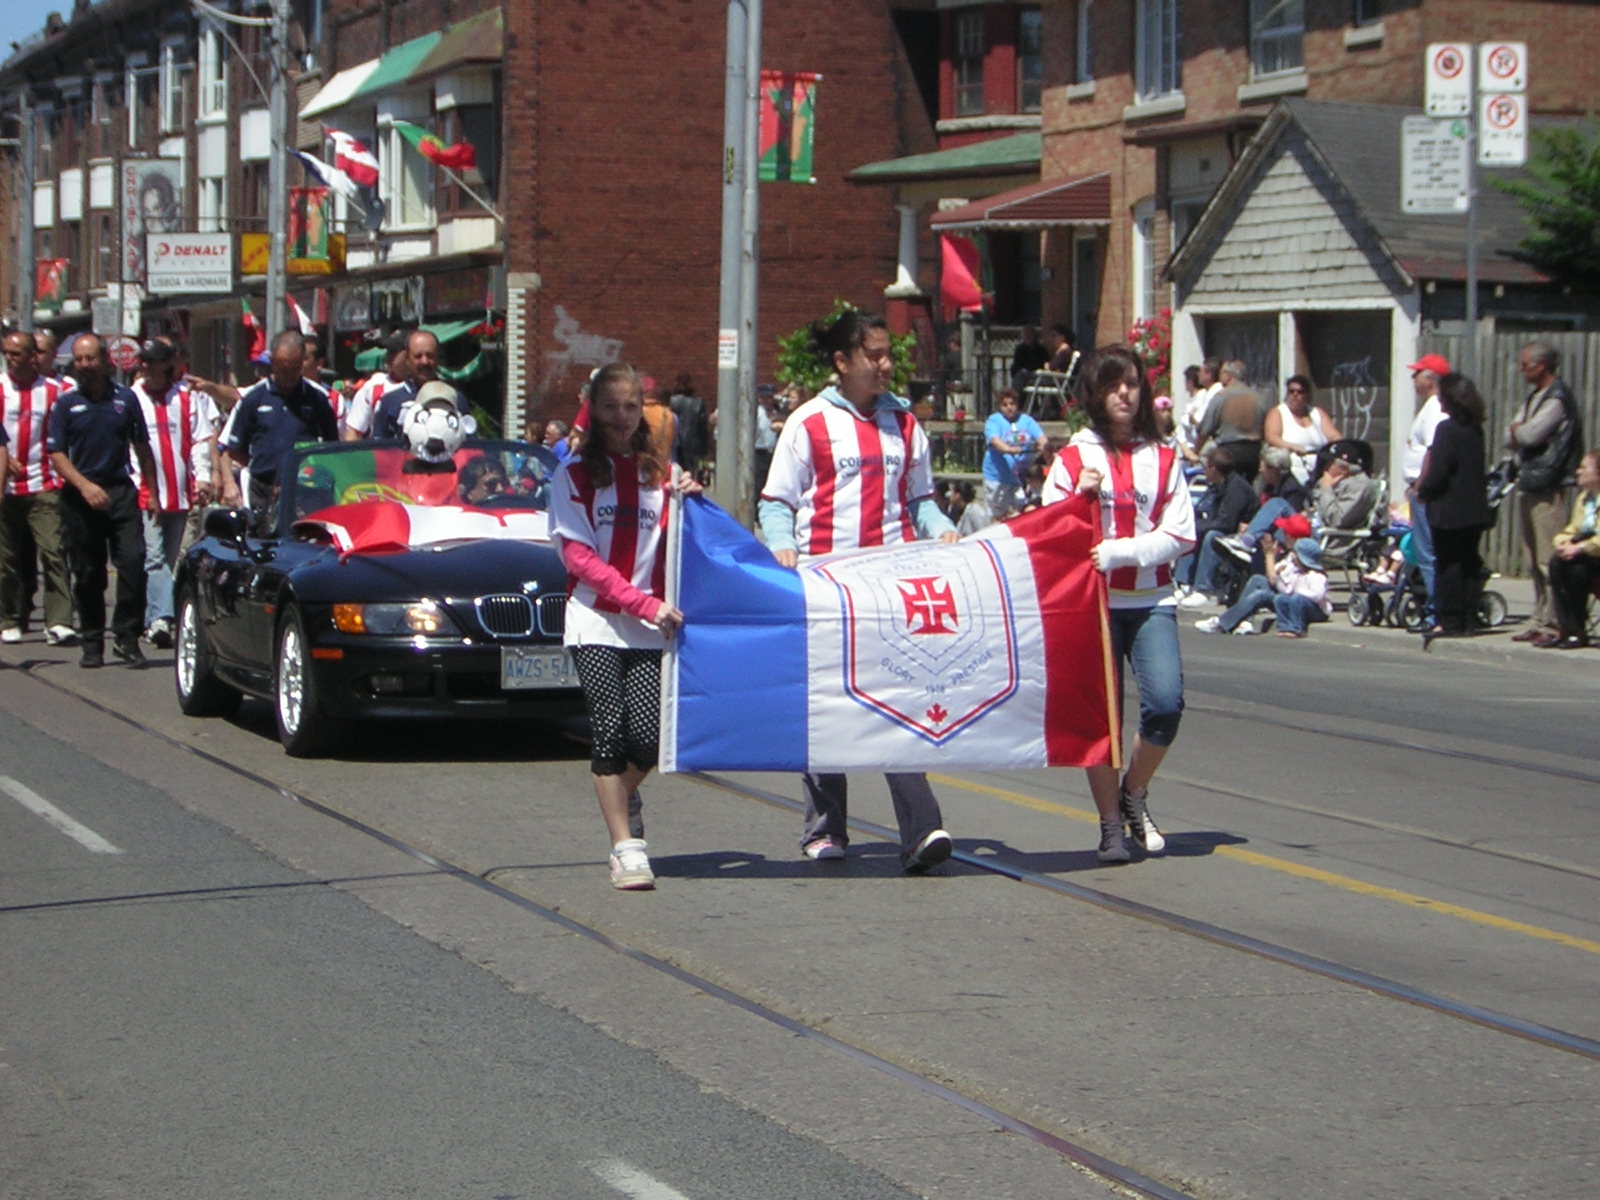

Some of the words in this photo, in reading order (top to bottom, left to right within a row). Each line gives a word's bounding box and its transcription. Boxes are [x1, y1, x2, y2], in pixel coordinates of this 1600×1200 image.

[174, 245, 227, 256] DENALT
[151, 278, 181, 287] LISBOA
[184, 277, 228, 287] HARDWARE
[507, 658, 542, 678] AWZS
[881, 658, 916, 683] GLORY
[951, 650, 994, 684] PRESTIGE
